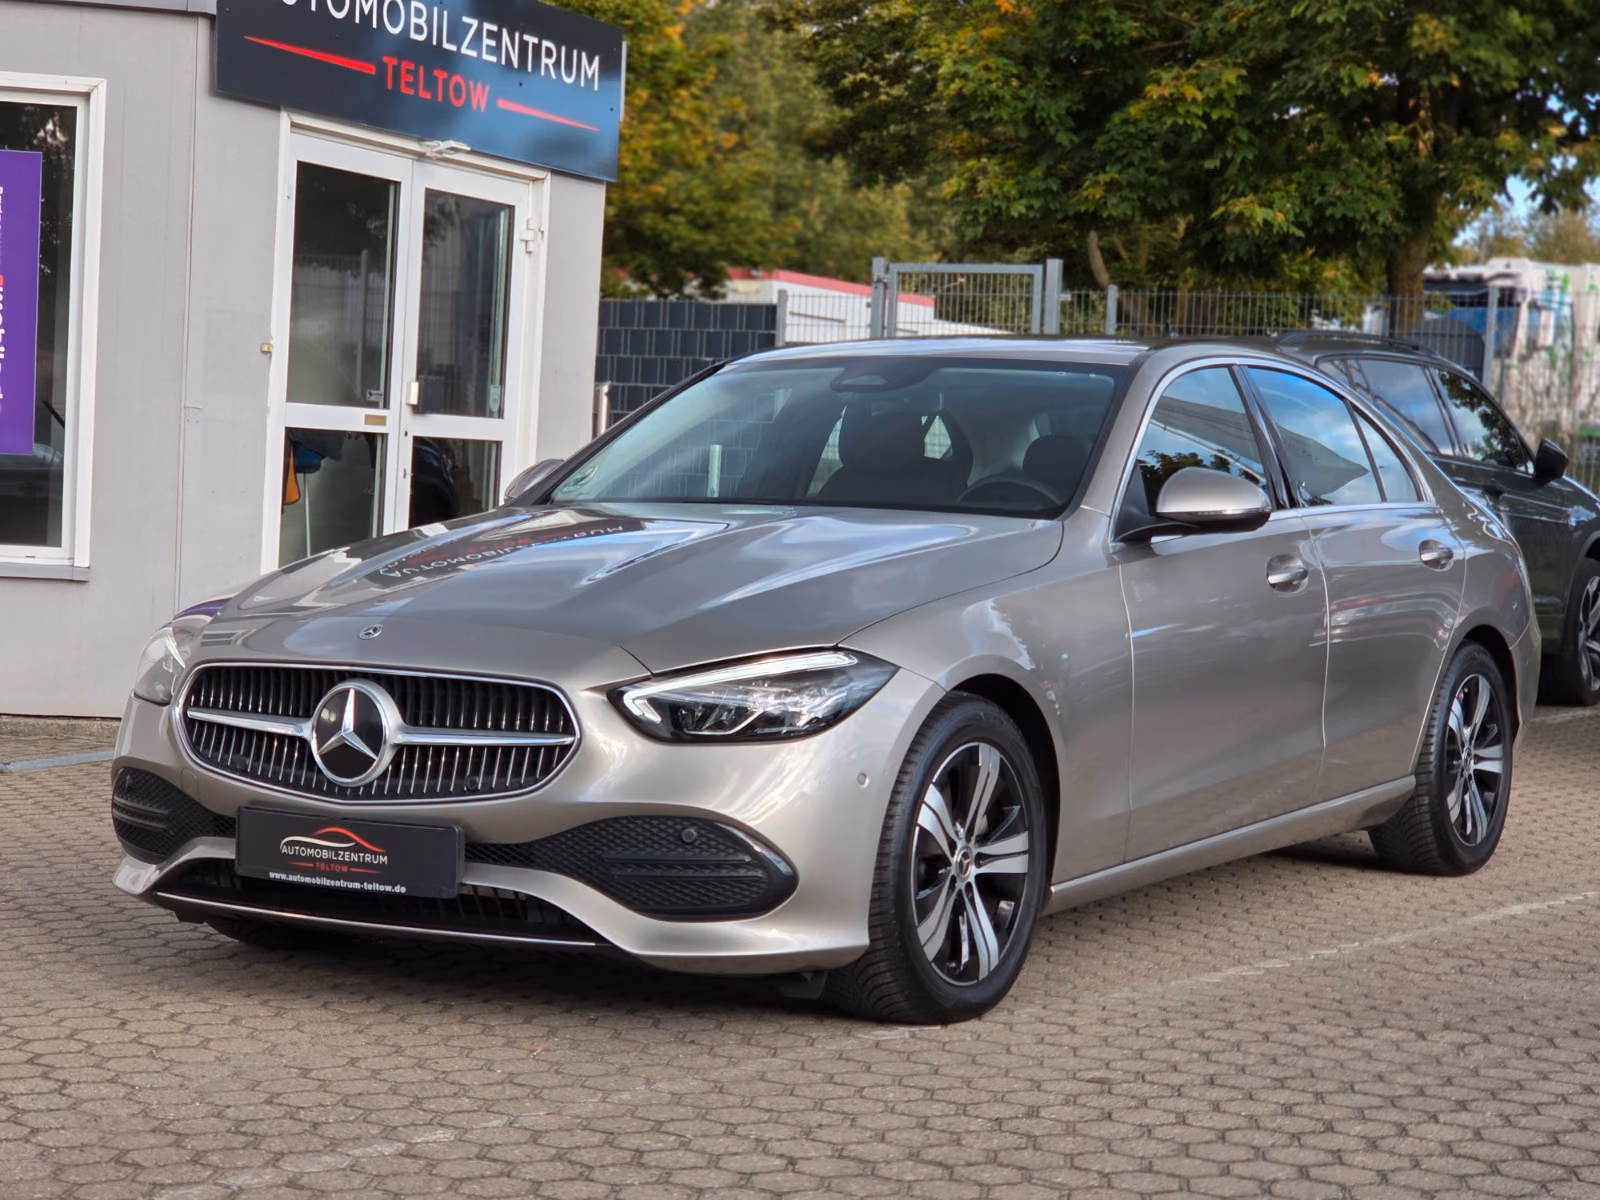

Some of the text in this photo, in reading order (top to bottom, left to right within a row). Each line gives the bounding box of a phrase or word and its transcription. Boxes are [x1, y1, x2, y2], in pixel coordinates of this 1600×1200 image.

[281, 0, 600, 91] OMOBILZENTRUM
[382, 56, 490, 112] TELTOW
[281, 845, 388, 865] AUTOMOBILZENTRUM
[315, 863, 349, 873] TELTOW
[269, 871, 406, 893] www.automobilzentrum-teltow.de
